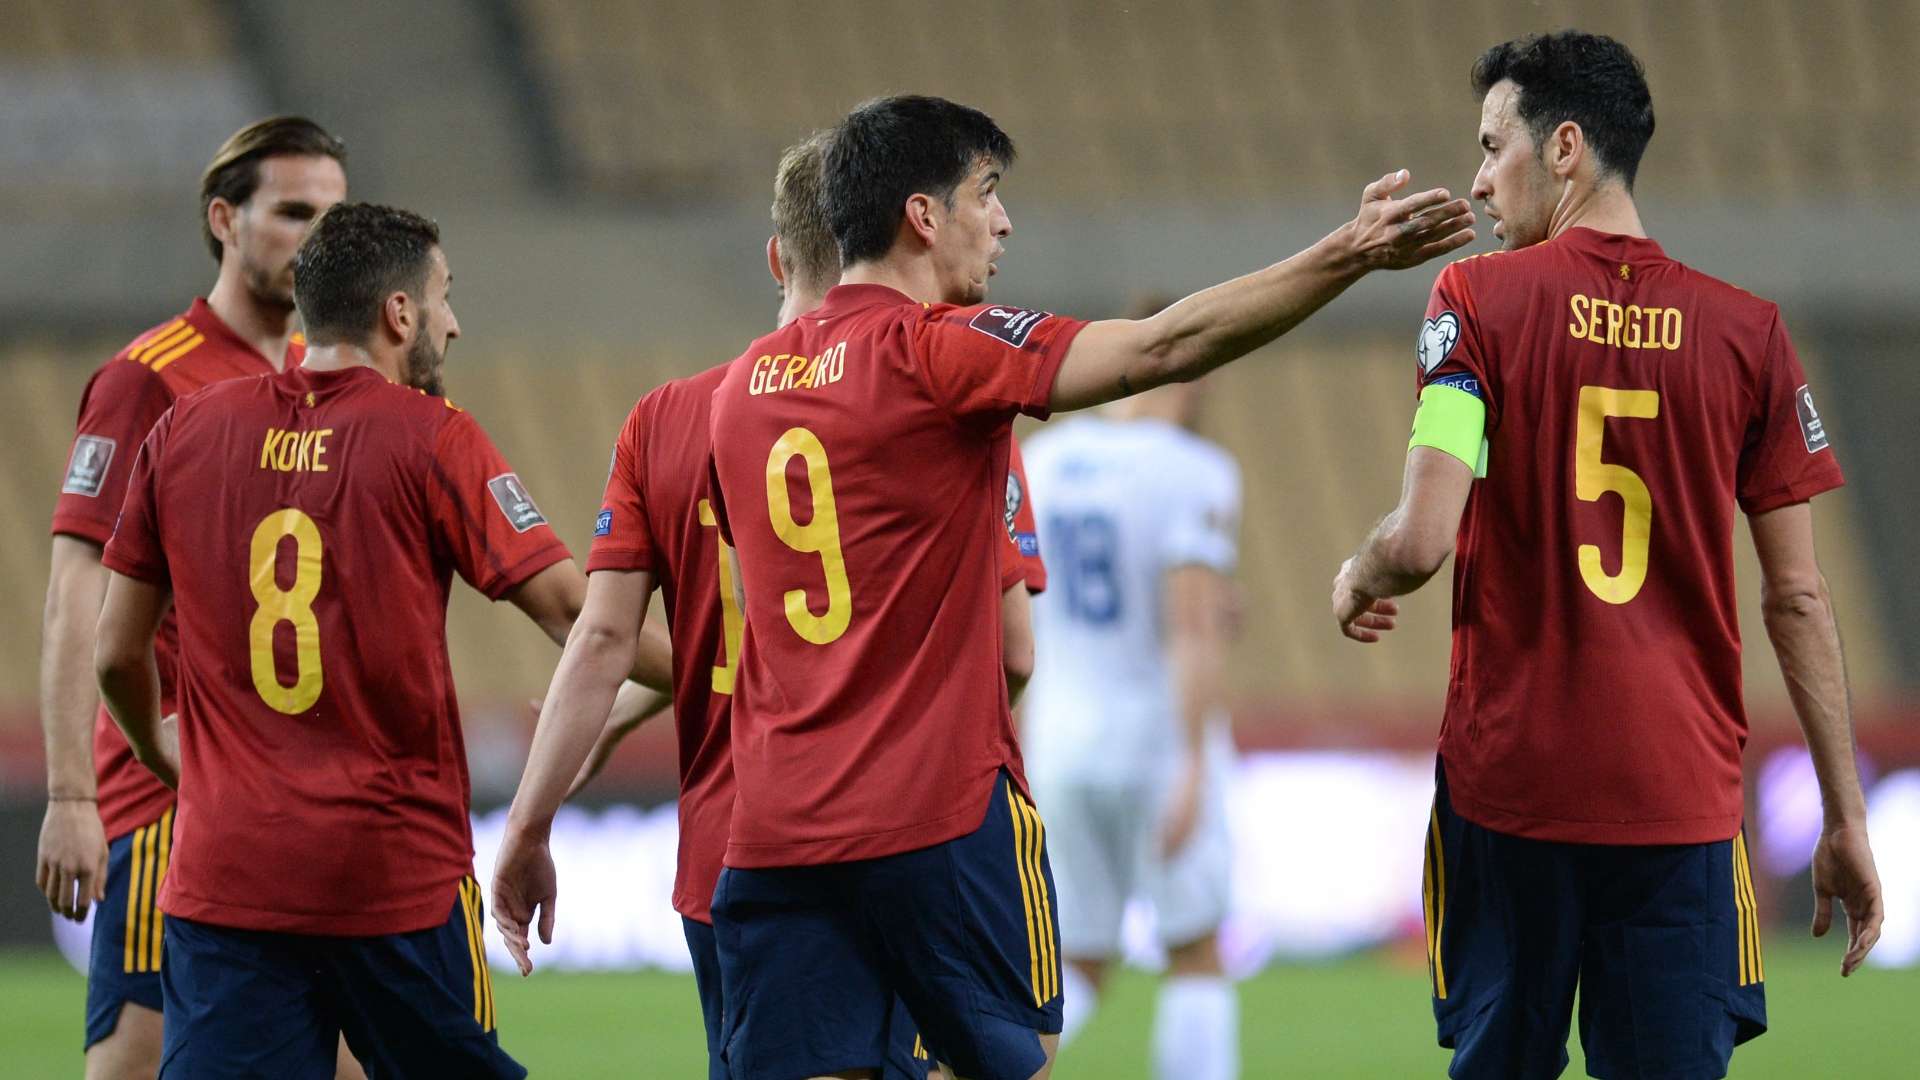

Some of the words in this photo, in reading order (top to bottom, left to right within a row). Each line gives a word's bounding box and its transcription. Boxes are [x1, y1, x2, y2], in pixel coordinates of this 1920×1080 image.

[749, 341, 847, 396] GERARD
[1569, 294, 1683, 350] SERGIO
[260, 428, 333, 472] KOKE
[1575, 385, 1660, 605] 5
[766, 427, 853, 645] 9
[249, 508, 324, 715] 8
